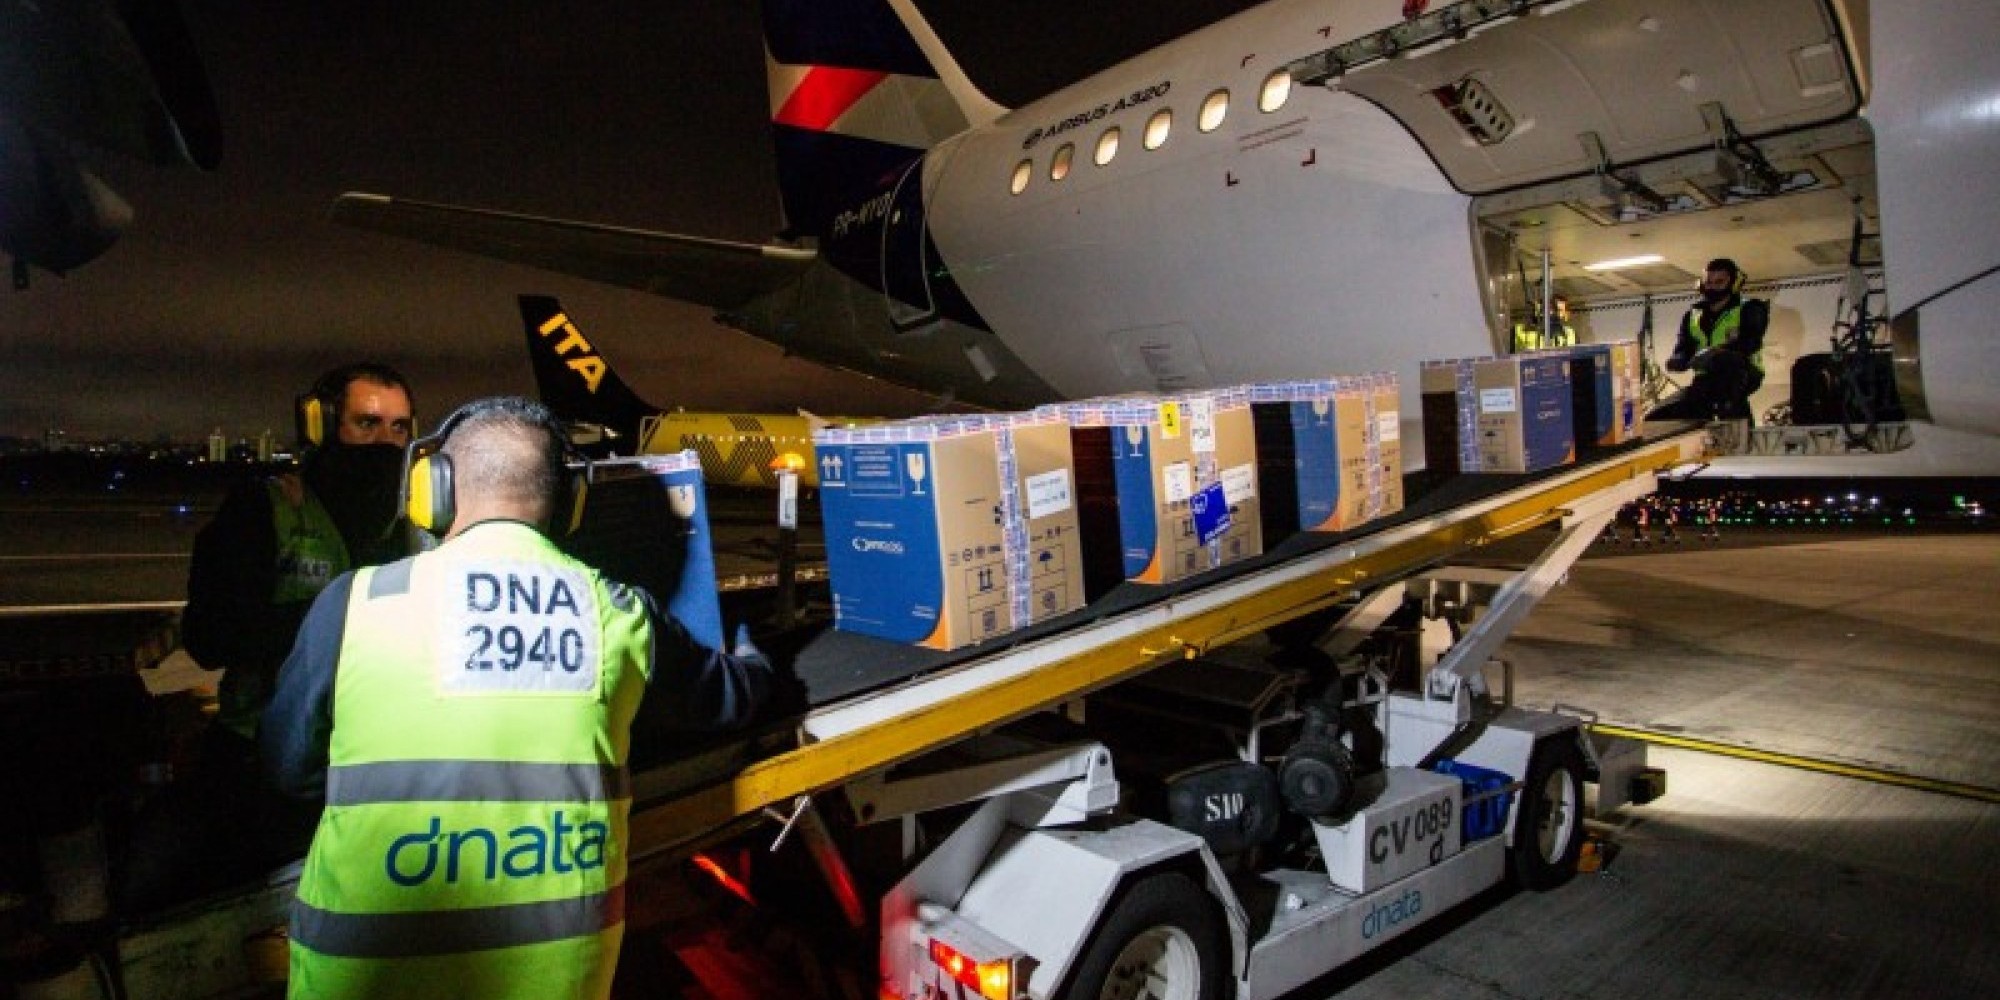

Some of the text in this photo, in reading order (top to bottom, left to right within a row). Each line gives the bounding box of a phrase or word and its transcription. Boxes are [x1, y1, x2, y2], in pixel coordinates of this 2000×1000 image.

[1042, 80, 1171, 139] AIRBUS A320
[538, 312, 606, 394] ITA
[466, 573, 580, 616] DNA
[465, 625, 584, 673] 2940
[385, 810, 608, 887] dnata
[1369, 796, 1452, 864] CV 089
[1360, 889, 1422, 940] dnata
